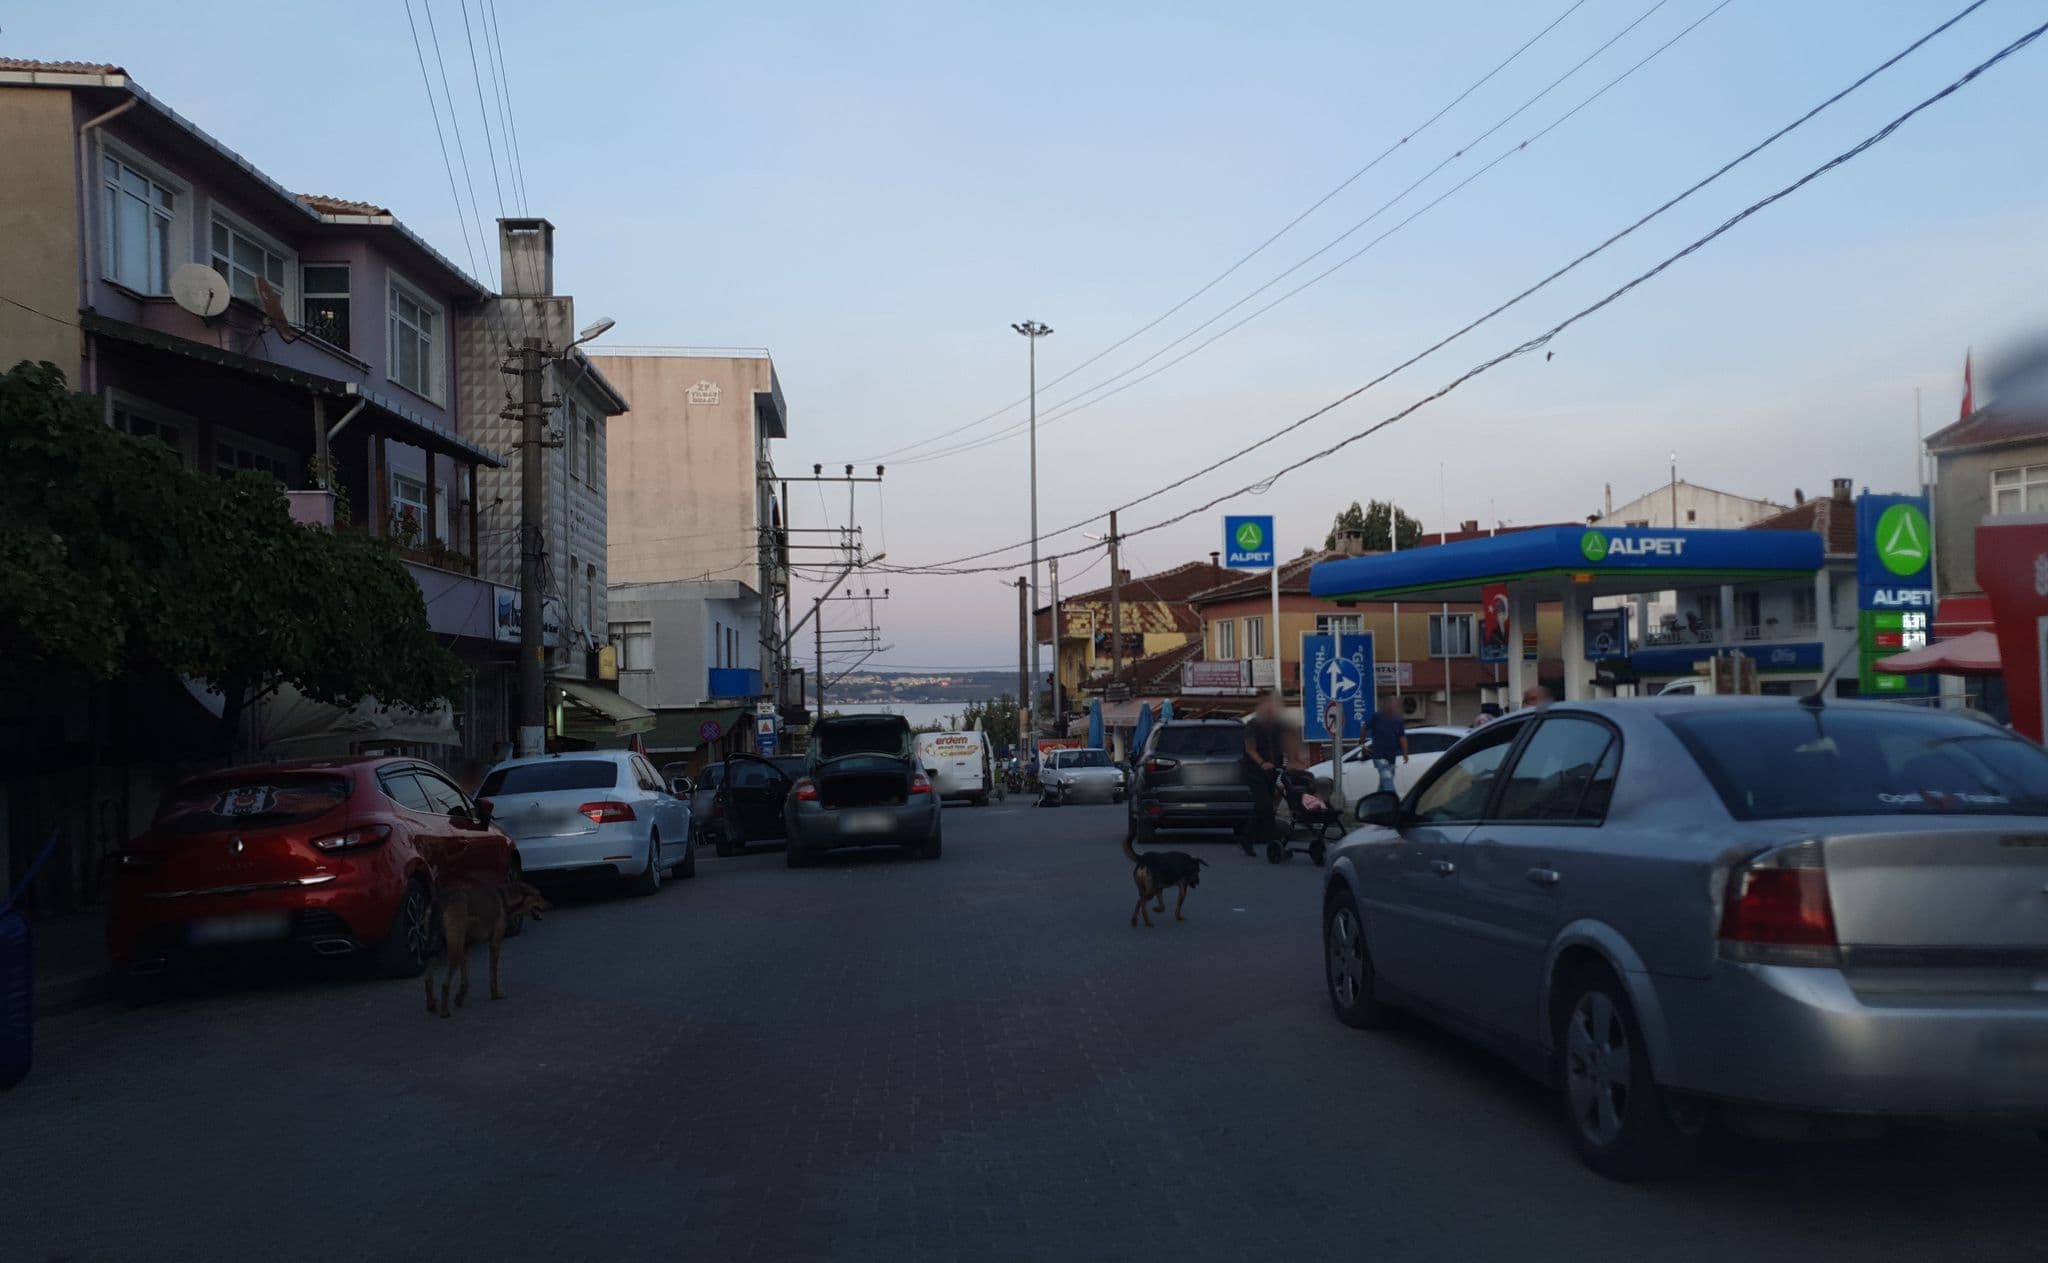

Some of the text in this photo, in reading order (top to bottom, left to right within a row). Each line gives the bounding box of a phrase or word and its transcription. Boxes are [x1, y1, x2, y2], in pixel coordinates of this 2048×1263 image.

[1608, 537, 1687, 556] ALPET
[1230, 552, 1270, 562] ALPET
[1872, 589, 1932, 605] ALPET
[936, 736, 968, 745] erdem
